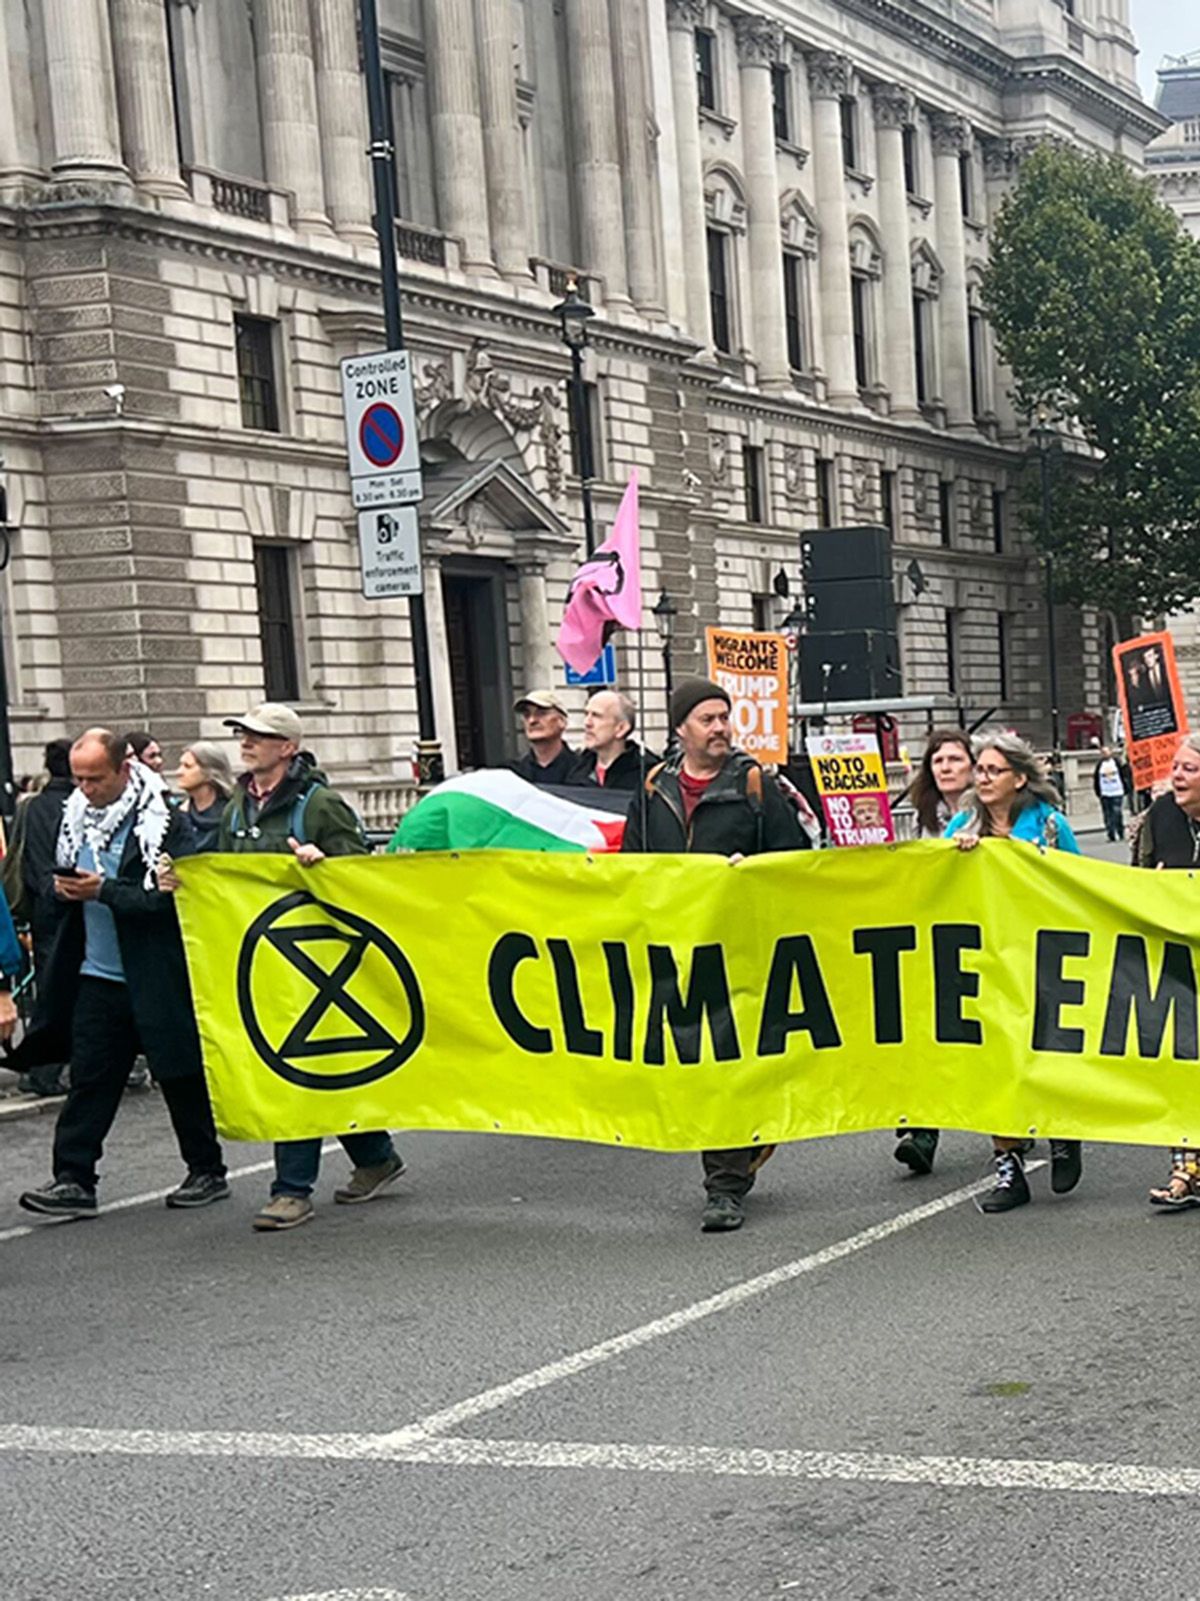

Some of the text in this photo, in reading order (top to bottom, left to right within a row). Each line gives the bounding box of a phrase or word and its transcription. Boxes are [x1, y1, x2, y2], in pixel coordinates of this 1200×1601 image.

[345, 357, 406, 379] Controlled
[356, 377, 399, 399] ZONE
[376, 550, 405, 561] Traffic
[365, 564, 418, 578] enforcement
[375, 582, 411, 592] cameras
[713, 635, 778, 654] MIGRANTS
[716, 652, 778, 670] WELCOME
[730, 698, 779, 735] OT
[817, 757, 865, 774] NO TO
[821, 773, 881, 791] RACISM
[826, 796, 850, 815] NO
[830, 812, 853, 830] TO
[834, 827, 889, 845] TRUMP
[488, 923, 983, 1065] CLIMATE
